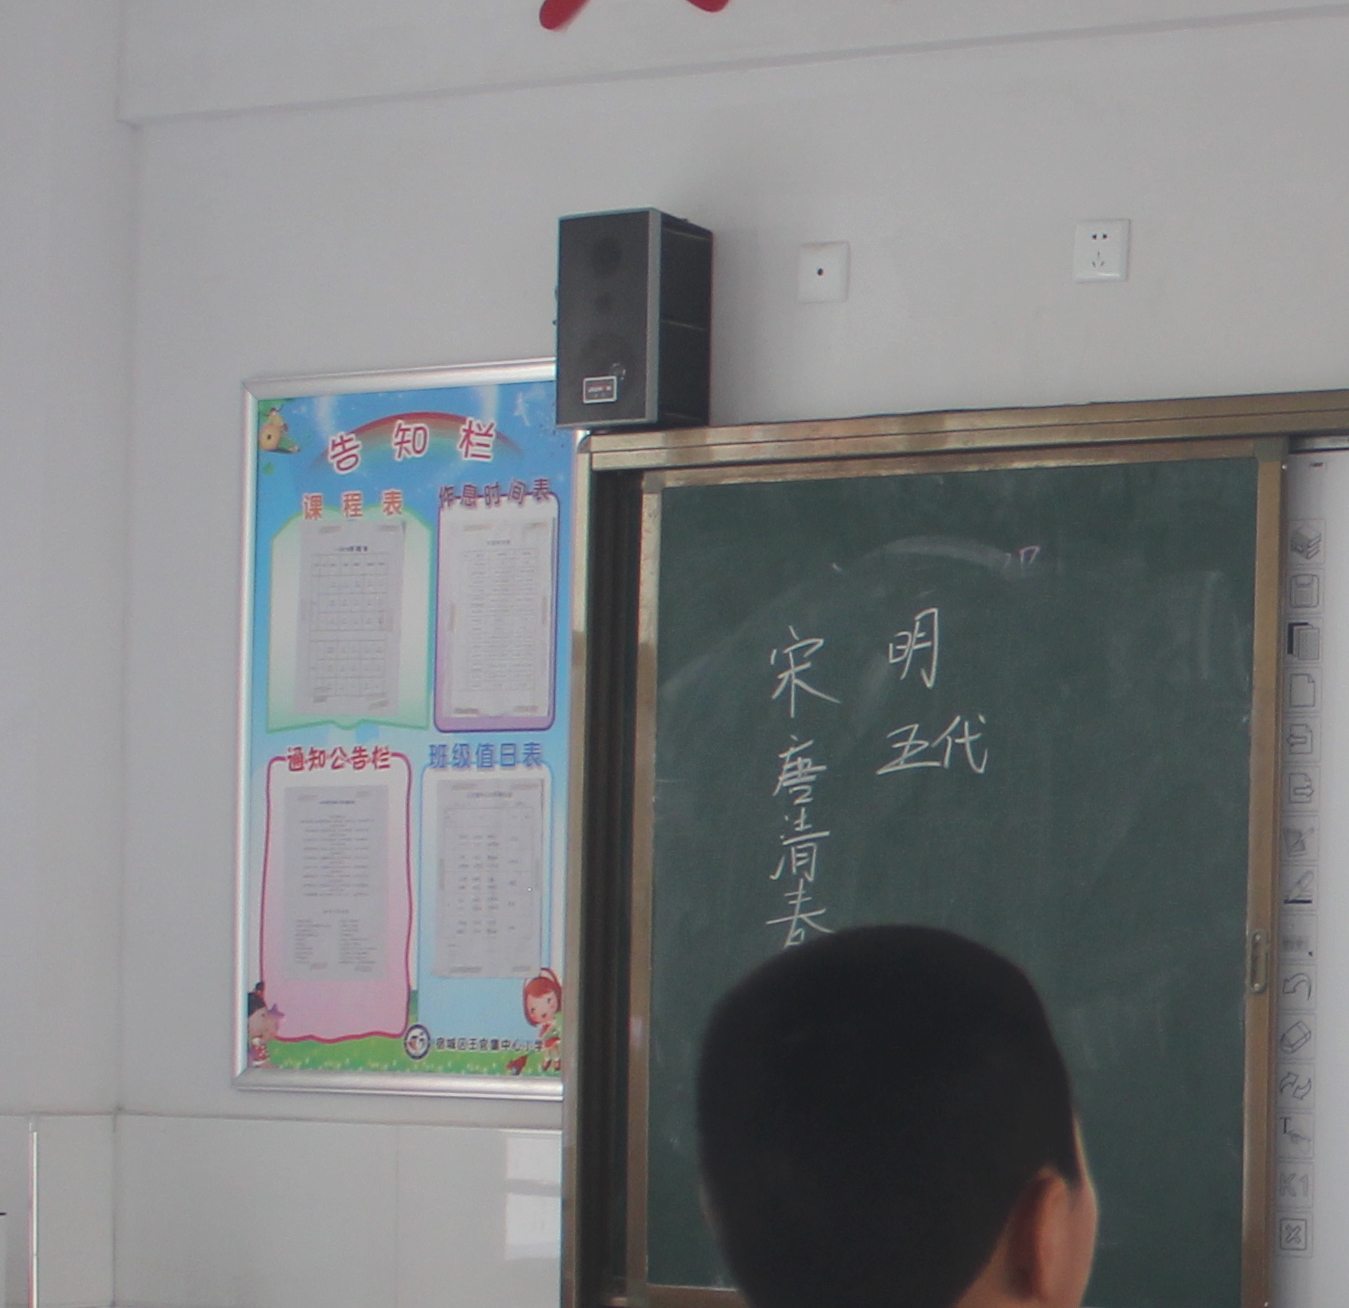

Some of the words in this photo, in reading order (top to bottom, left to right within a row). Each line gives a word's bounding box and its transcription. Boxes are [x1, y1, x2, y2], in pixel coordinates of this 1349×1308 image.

[329, 419, 496, 473] 告知栏
[303, 490, 403, 520] 课程表
[438, 478, 550, 508] 作息时间表
[888, 607, 939, 688] 明
[286, 746, 391, 771] 通知公告栏
[428, 742, 543, 769] 班级值日表
[876, 713, 988, 775] 五代
